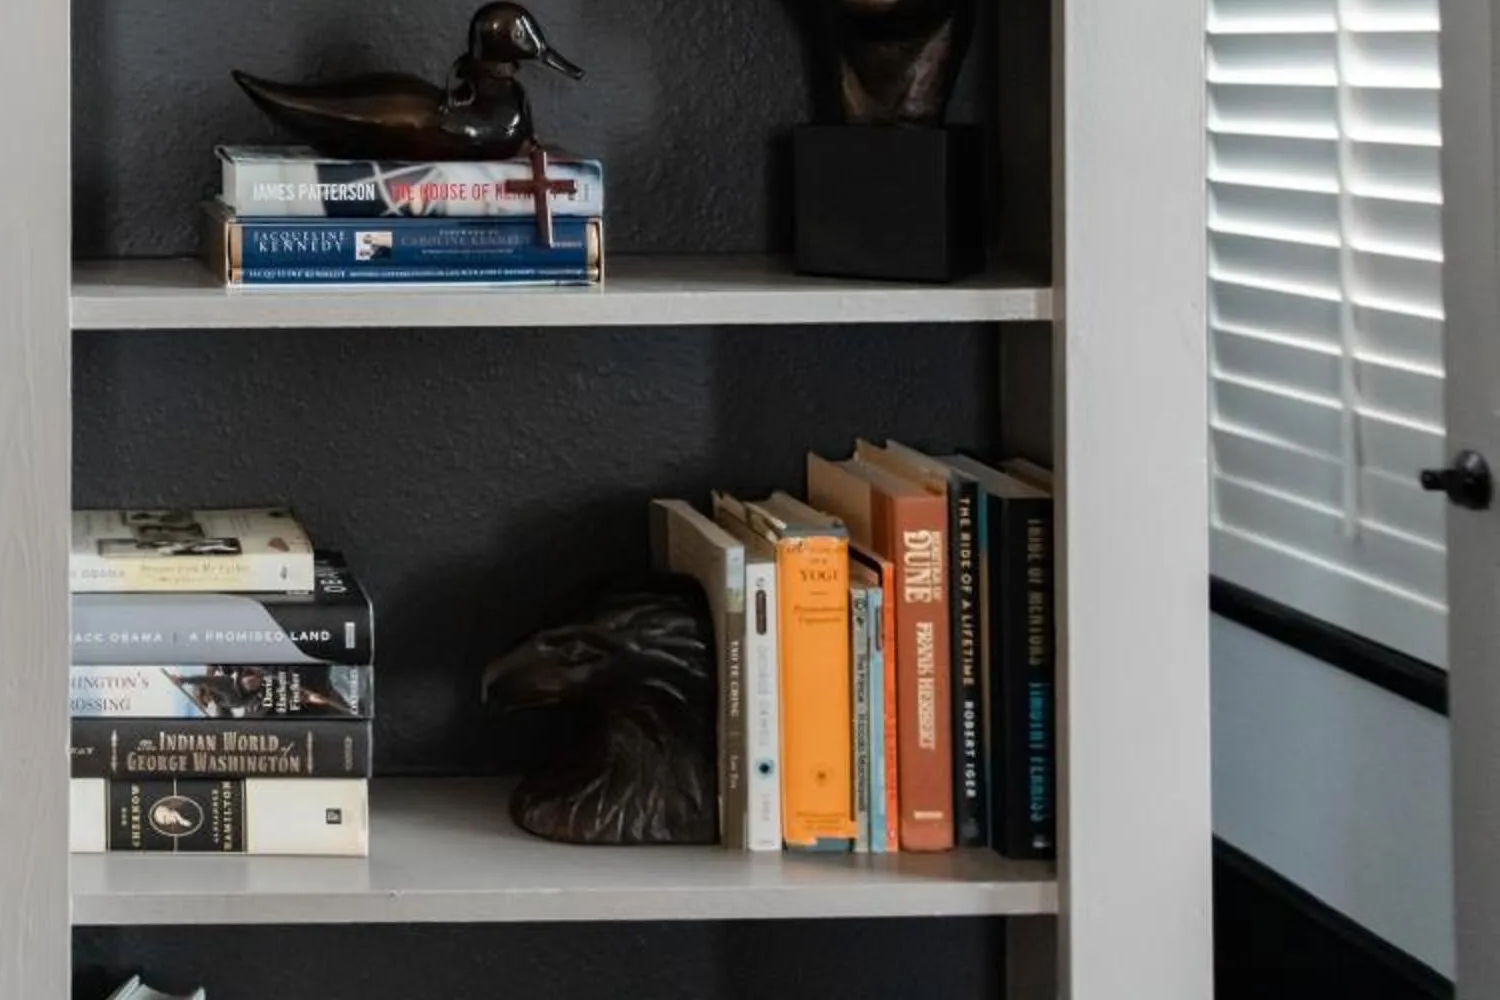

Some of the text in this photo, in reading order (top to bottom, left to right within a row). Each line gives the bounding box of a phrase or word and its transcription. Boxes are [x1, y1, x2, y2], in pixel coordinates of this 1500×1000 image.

[252, 182, 296, 201] JAMES
[298, 182, 375, 201] PATTERSON
[418, 182, 470, 201] HOUSE
[471, 182, 490, 201] OF
[253, 230, 346, 242] JACQUELINE
[258, 241, 344, 253] KENNEDY
[799, 568, 838, 582] YOGI
[903, 530, 932, 604] DUNE
[111, 631, 164, 643] OBAMA
[205, 630, 284, 642] PROMISED
[290, 630, 331, 642] LAND
[958, 497, 977, 799] THE RIDE OF A LIFETIME ROBERT IGER
[915, 621, 937, 750] FRANK HERBERT
[730, 680, 740, 718] CHING
[158, 731, 220, 751] INDIAN
[222, 731, 279, 752] WORLD
[126, 752, 300, 774] GEORGE WASHINGTON
[131, 783, 141, 848] CHERNOW
[222, 781, 233, 851] HAMILTON
